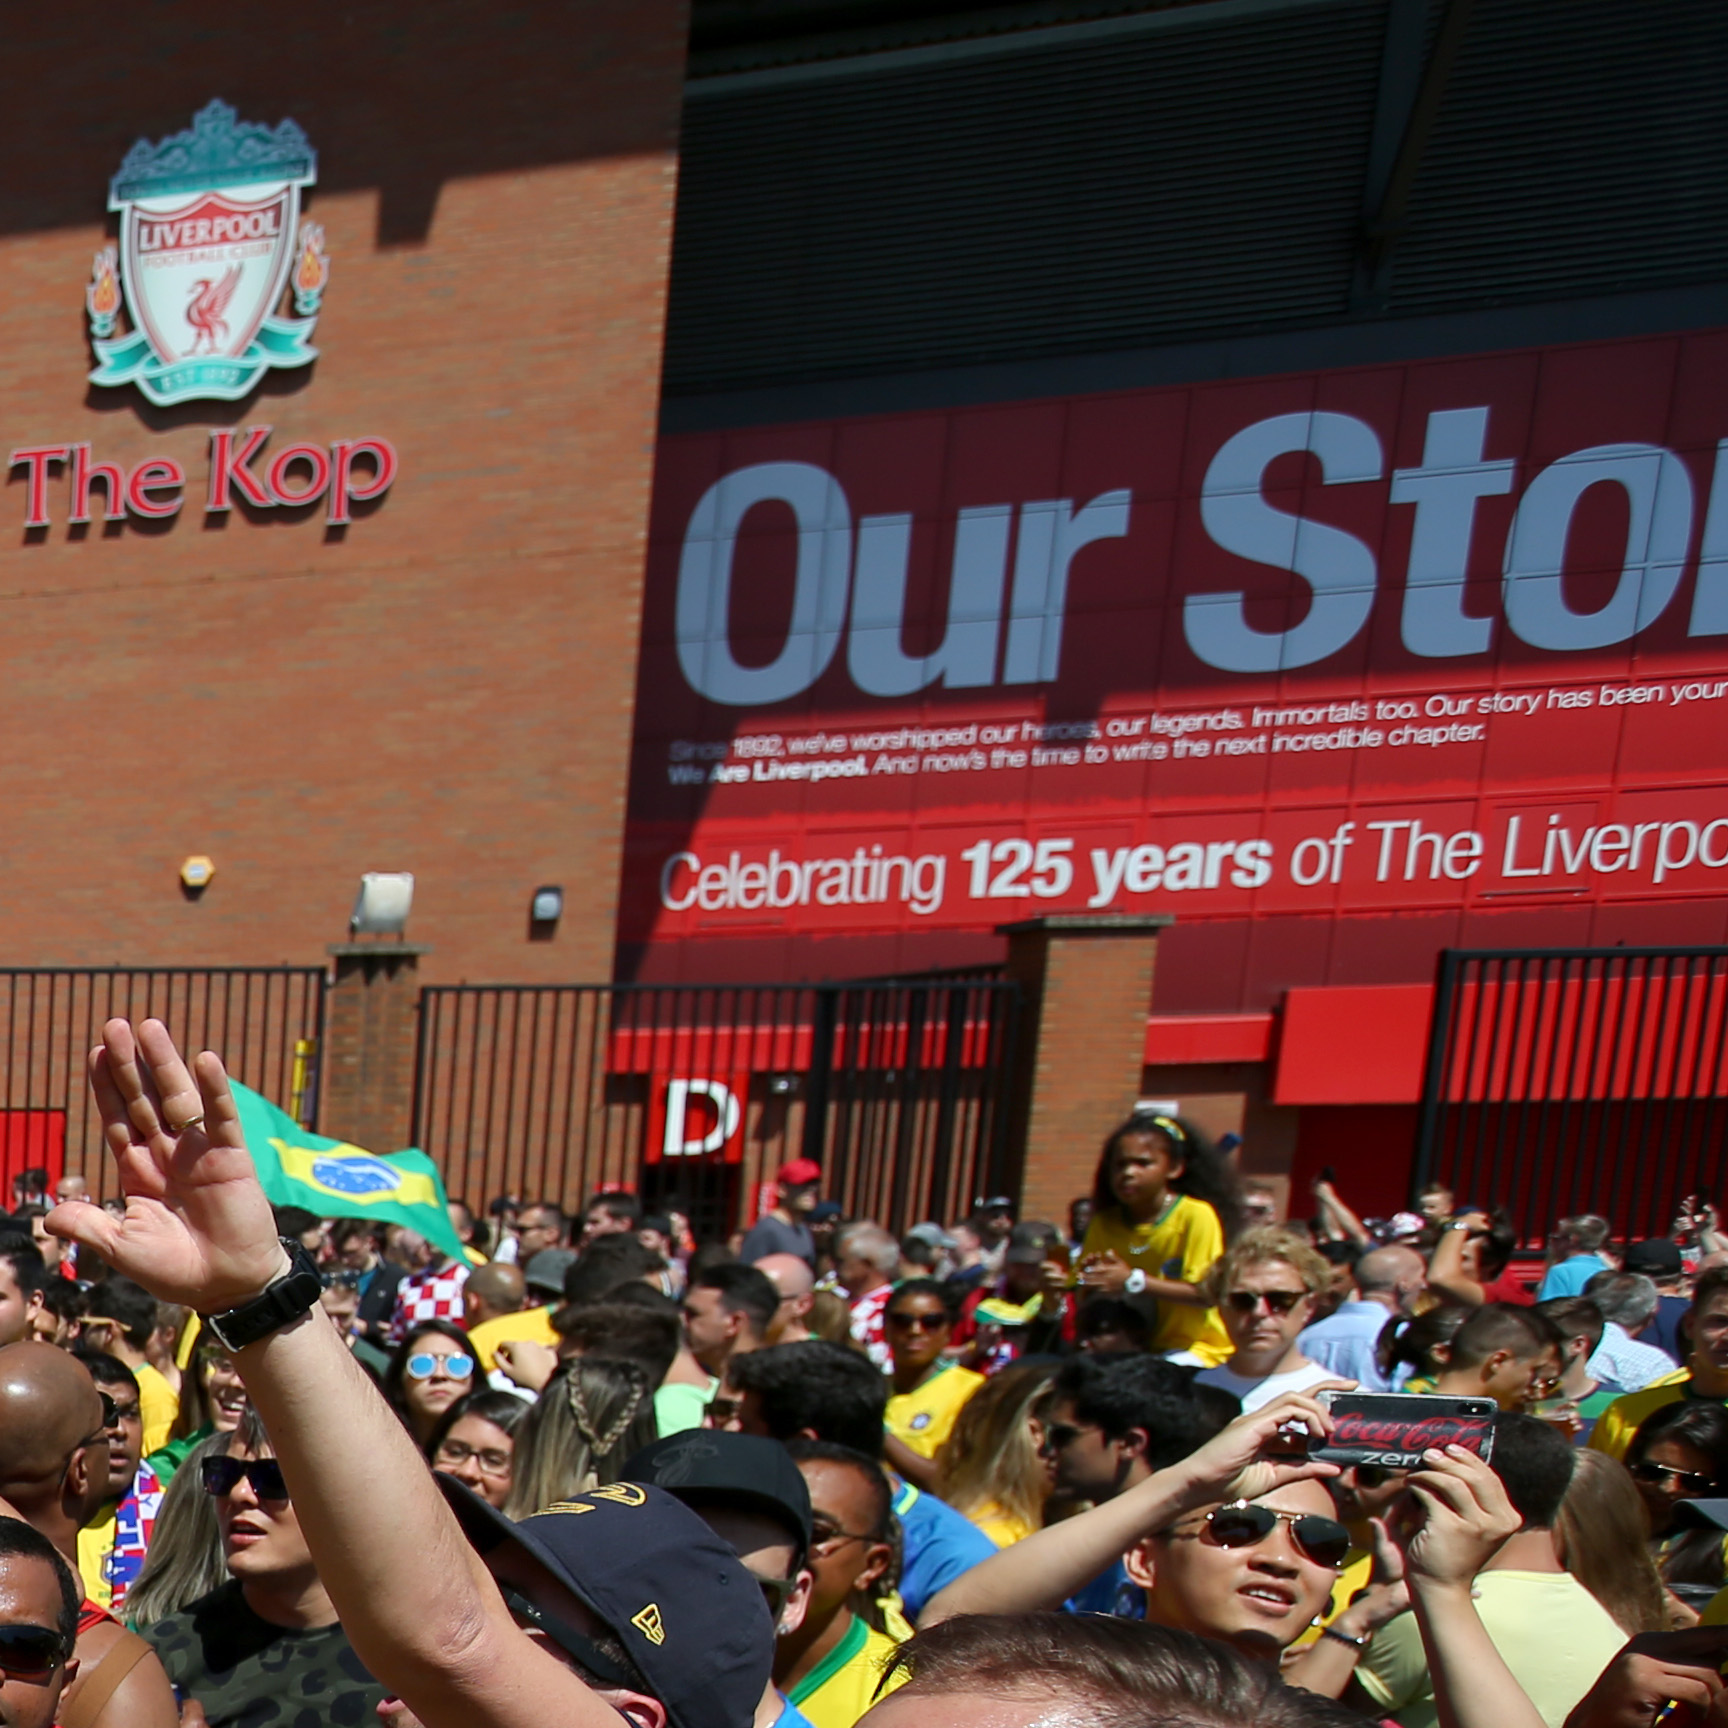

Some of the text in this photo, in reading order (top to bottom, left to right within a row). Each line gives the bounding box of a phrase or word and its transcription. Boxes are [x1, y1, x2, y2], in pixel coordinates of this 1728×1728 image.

[140, 210, 281, 251] LIVERPOOL
[10, 425, 397, 527] The Kop
[675, 460, 1132, 706] Our
[668, 738, 729, 762] Since
[850, 723, 976, 756] worshipped
[978, 724, 1019, 746] our
[1105, 715, 1147, 738] our
[1150, 705, 1245, 734] legends.
[1251, 700, 1368, 729] Immortals
[1425, 693, 1474, 719] Our
[1477, 691, 1541, 719] story
[1547, 686, 1593, 711] has
[1599, 682, 1665, 706] been
[1670, 679, 1728, 706] your
[668, 761, 708, 786] We
[709, 760, 750, 785] Are
[872, 749, 919, 774] And
[921, 748, 989, 773] now's
[990, 746, 1028, 770] the
[1029, 743, 1081, 769] time
[1083, 741, 1110, 766] to
[1112, 737, 1170, 765] write
[1172, 734, 1211, 760] the
[1213, 732, 1266, 757] next
[1271, 725, 1384, 755] incredible
[1387, 721, 1486, 751] chapter.
[660, 844, 946, 915] Celebrating
[961, 836, 1075, 899] 125
[1087, 835, 1272, 908] years
[1290, 822, 1356, 887] of
[1366, 818, 1484, 882] The
[663, 1078, 741, 1157] D
[1360, 1450, 1423, 1468] zer
